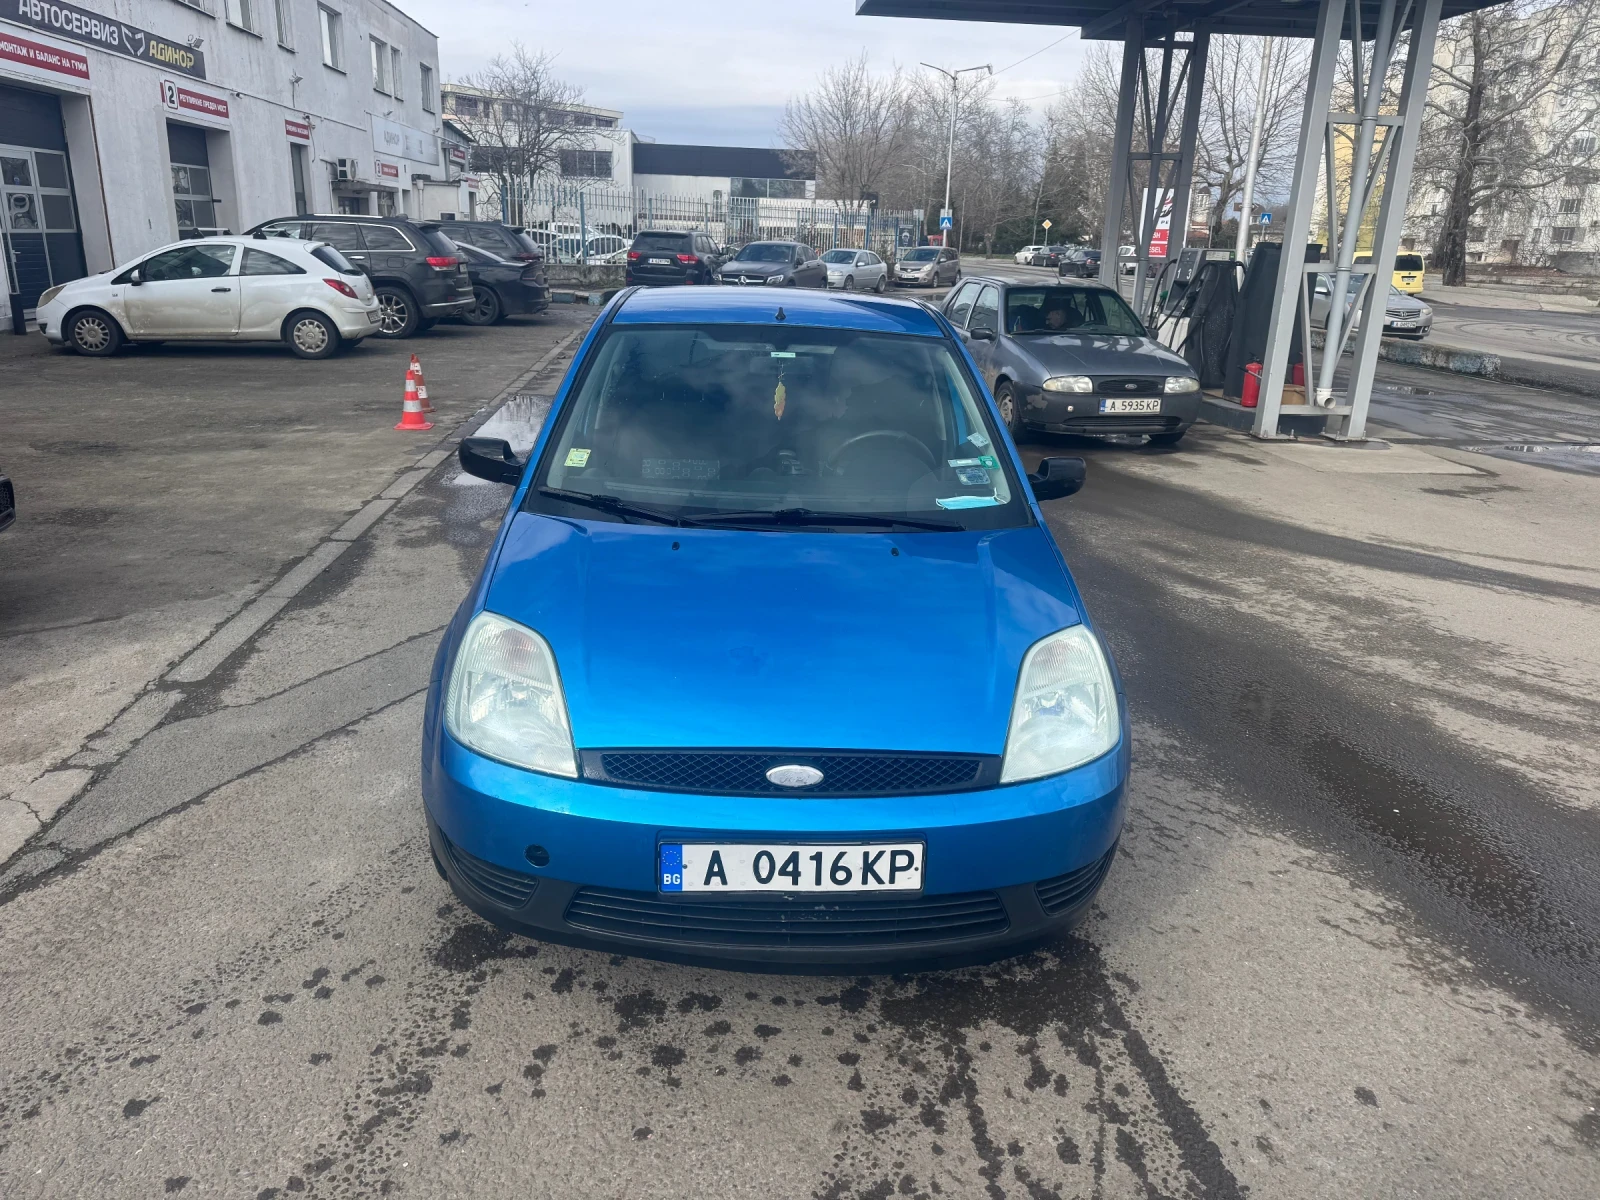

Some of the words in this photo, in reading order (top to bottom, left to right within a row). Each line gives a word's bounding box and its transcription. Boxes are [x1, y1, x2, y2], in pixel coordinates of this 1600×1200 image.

[18, 0, 119, 45] АВТОСЕРВИЗ
[29, 48, 35, 59] И
[36, 50, 61, 66] БАЛАНС
[61, 57, 71, 69] НА
[71, 60, 88, 73] ГУМИ
[167, 85, 176, 104] 2
[1109, 400, 1116, 411] A
[703, 849, 728, 886] A
[663, 873, 681, 885] BG
